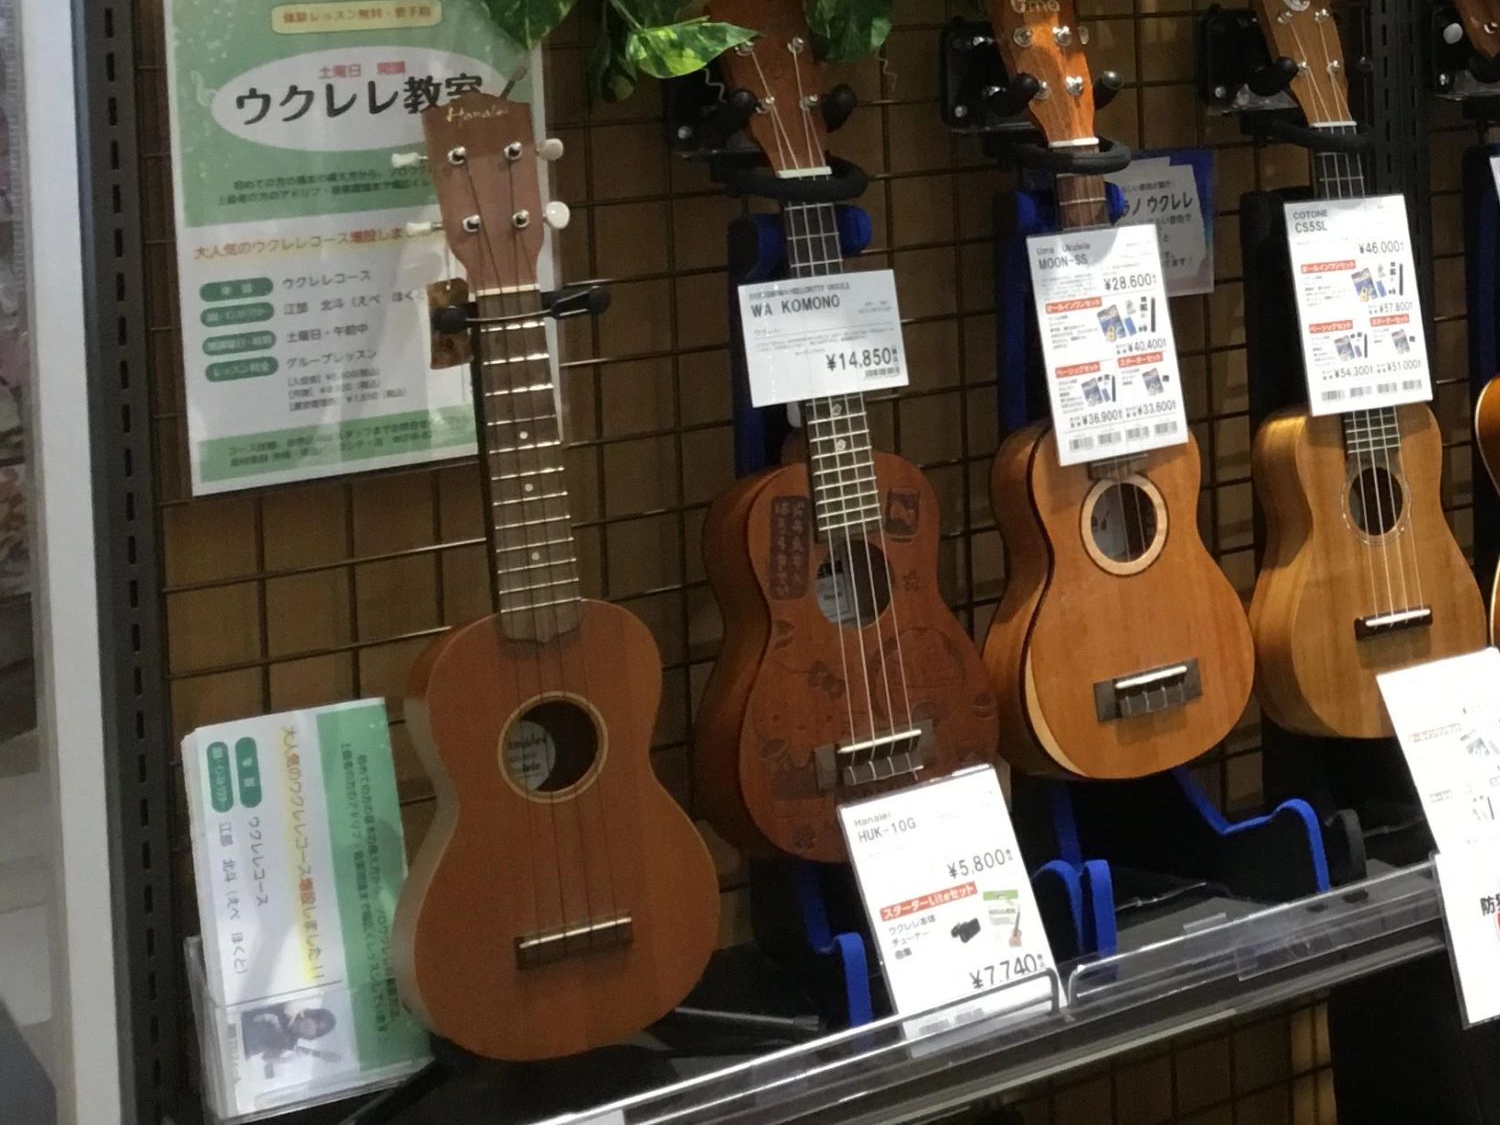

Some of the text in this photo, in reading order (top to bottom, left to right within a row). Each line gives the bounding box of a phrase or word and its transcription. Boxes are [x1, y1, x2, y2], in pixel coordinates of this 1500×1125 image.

[751, 294, 841, 318] WA KOMONO
[826, 346, 893, 372] ¥14,850
[858, 817, 917, 844] HUK-10G
[248, 816, 269, 908] ウクレレコース
[947, 848, 1007, 880] ¥5,800
[969, 952, 1038, 990] ¥7,740
